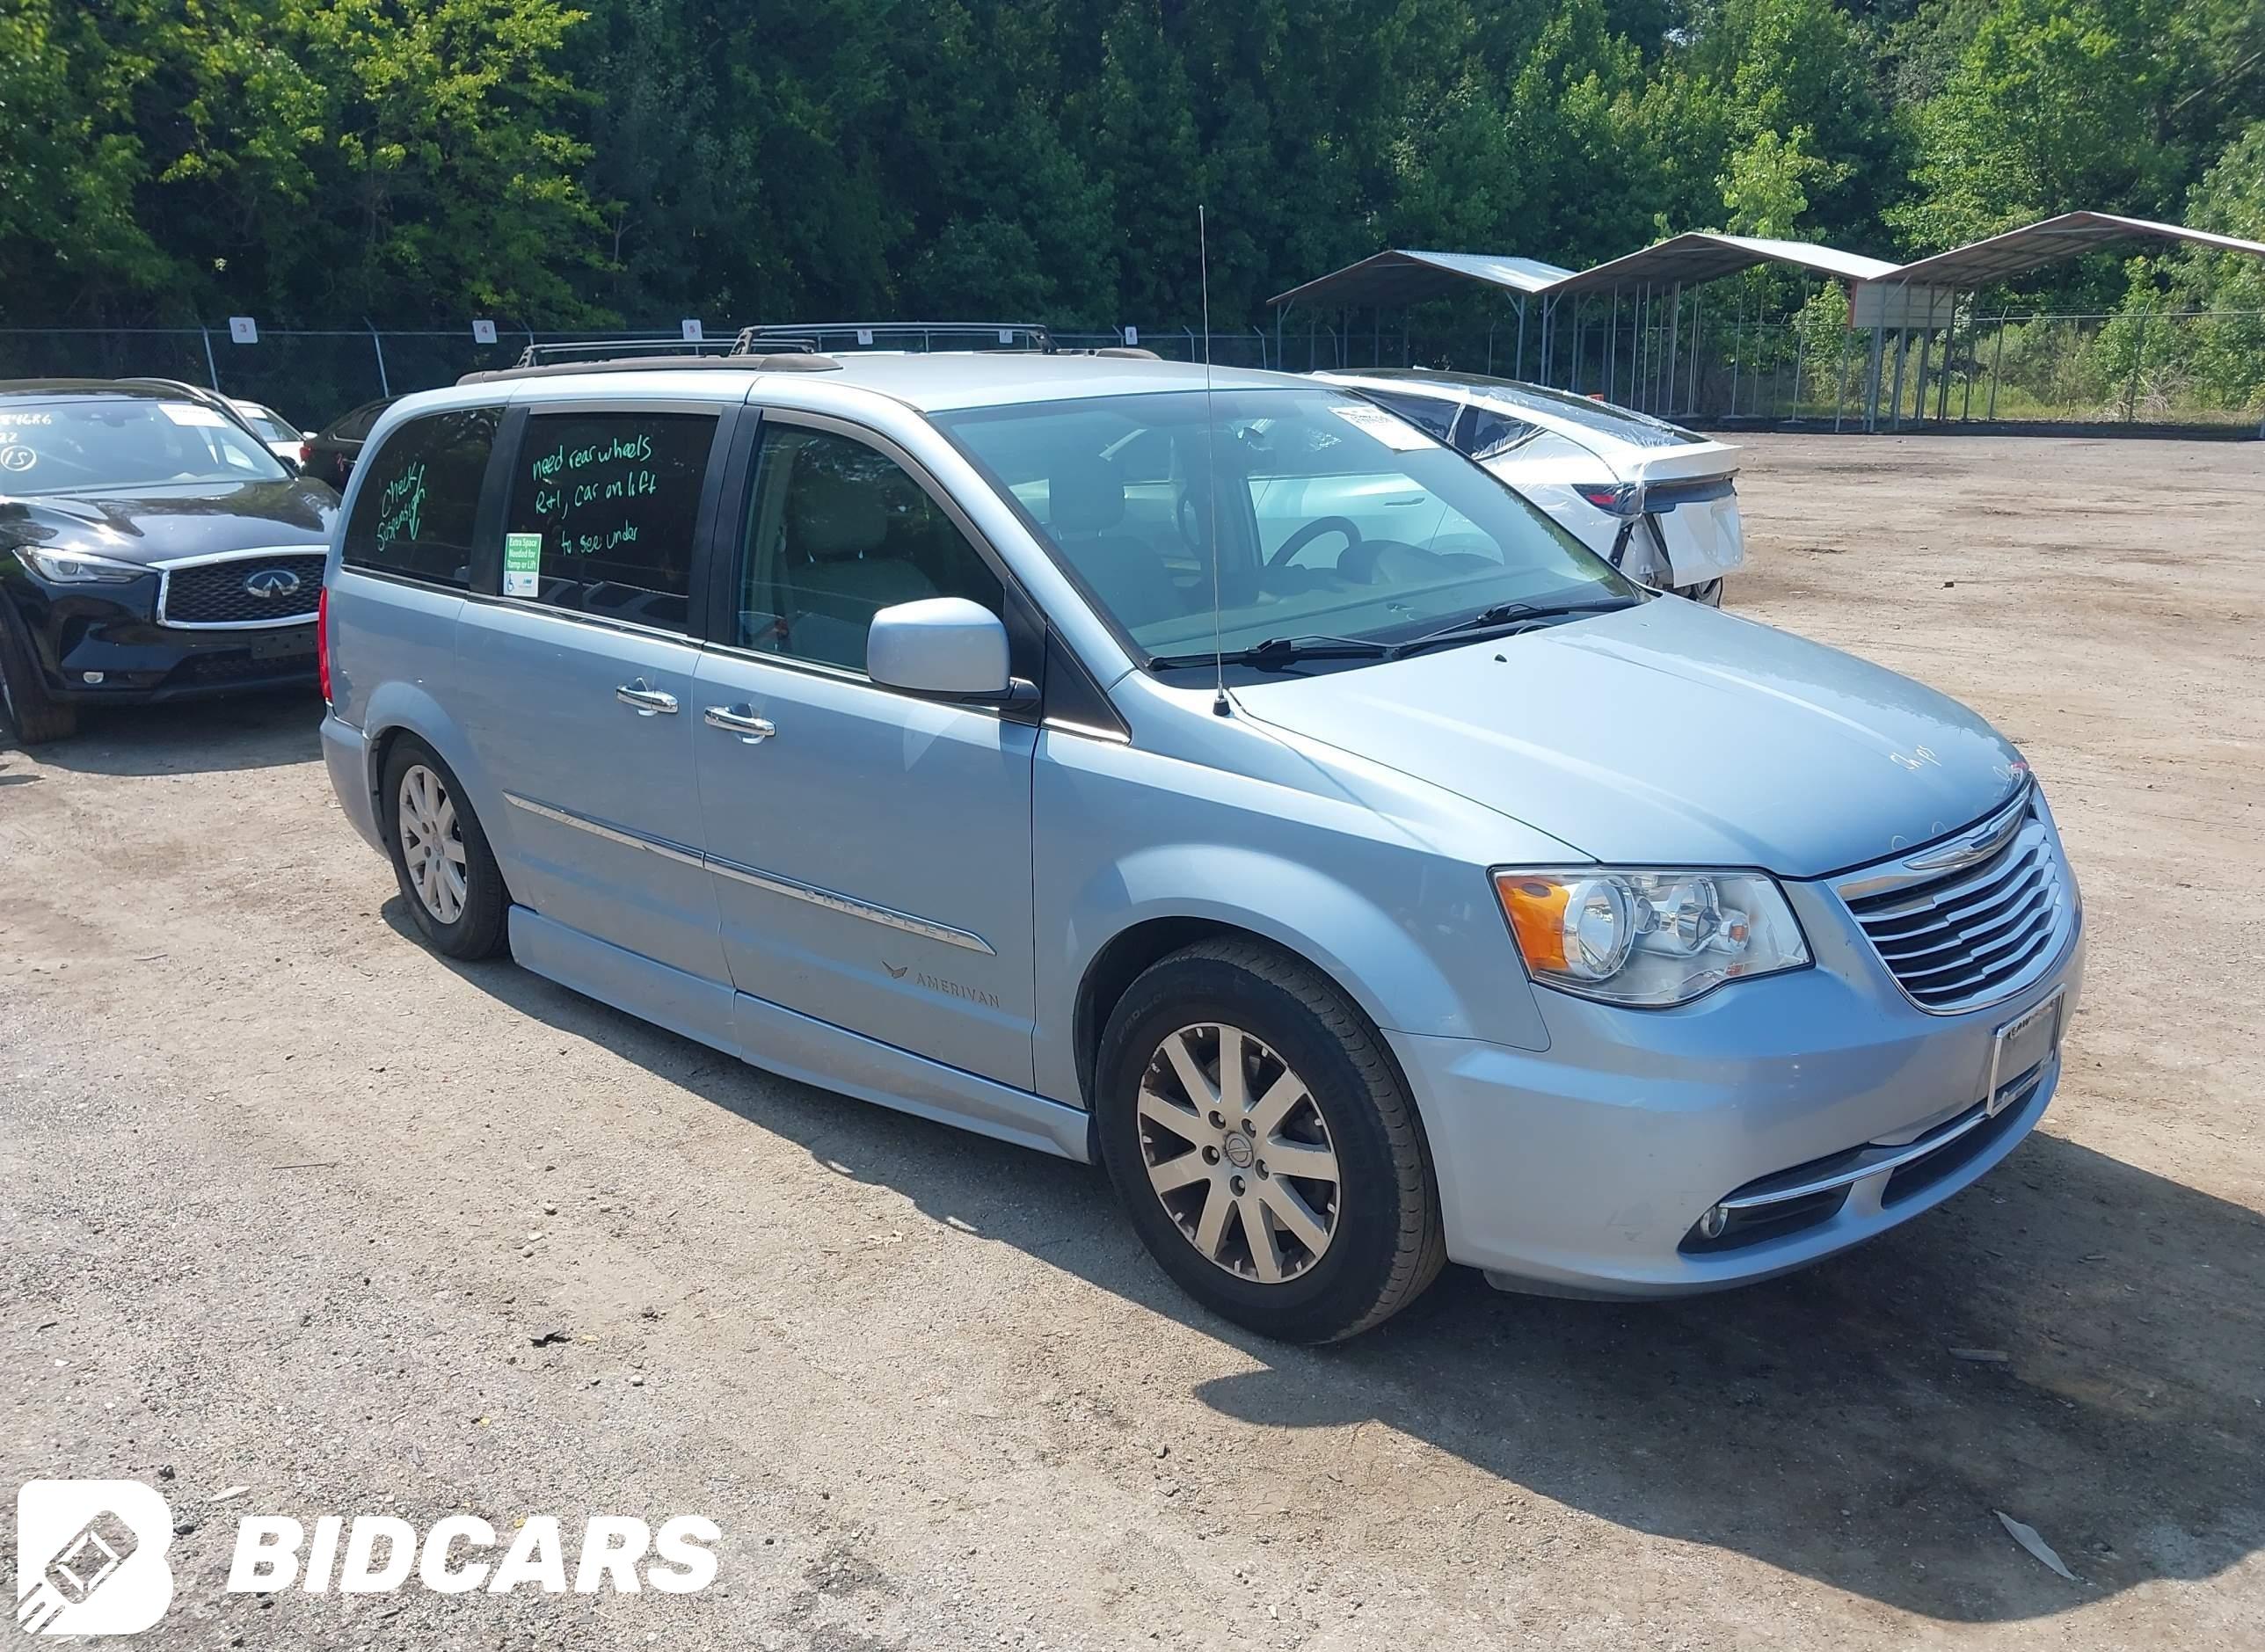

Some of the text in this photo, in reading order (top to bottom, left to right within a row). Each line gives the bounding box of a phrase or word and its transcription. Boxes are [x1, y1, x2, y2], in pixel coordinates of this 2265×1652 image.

[239, 323, 247, 333] 3
[481, 325, 488, 334] 4
[533, 434, 652, 481] need rear wheels
[605, 480, 623, 499] on
[628, 469, 657, 497] lift
[509, 537, 537, 549] Extra Space
[561, 519, 638, 556] to see under
[509, 548, 528, 558] Needed
[506, 559, 521, 571] Ramp
[527, 559, 536, 571] Lift
[916, 972, 1000, 1008] AMERIVAN
